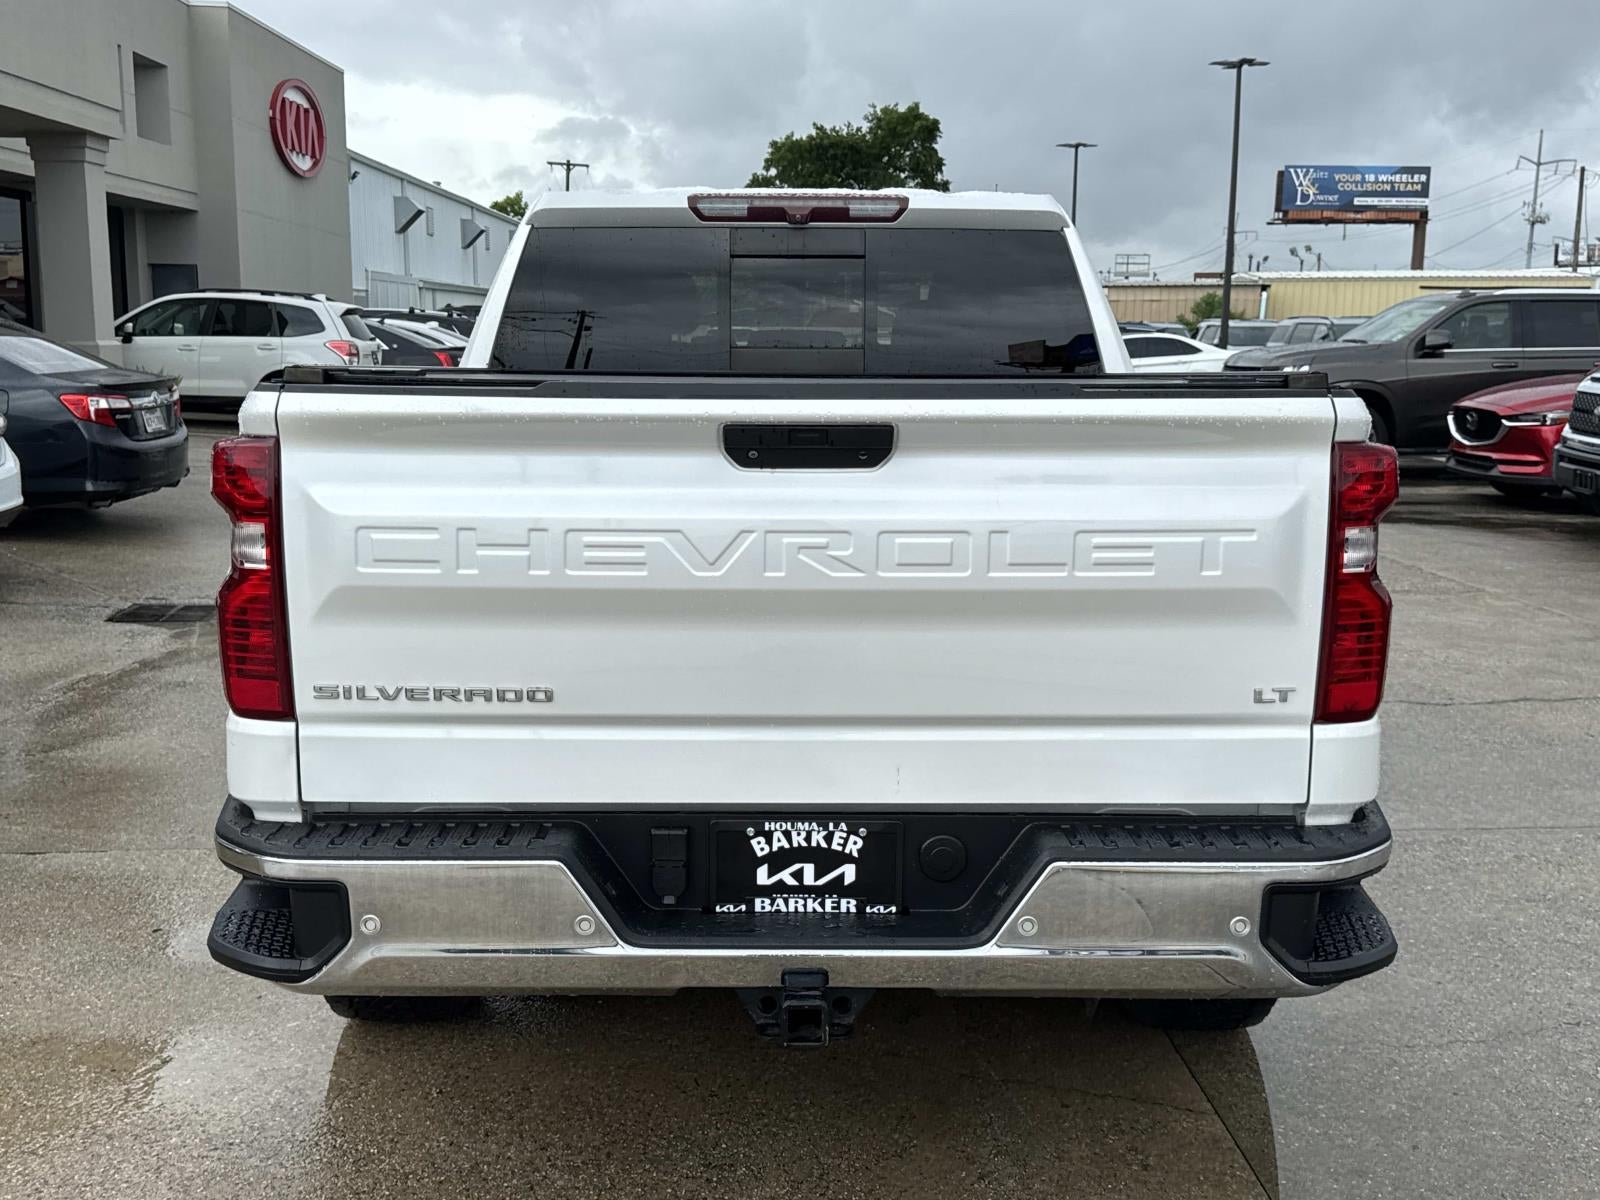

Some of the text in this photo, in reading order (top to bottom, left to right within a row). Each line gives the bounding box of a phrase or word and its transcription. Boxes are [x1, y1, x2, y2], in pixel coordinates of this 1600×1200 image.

[281, 96, 321, 161] KIA
[1334, 173, 1427, 184] YOUR 18 WHEELER
[1337, 182, 1422, 193] COLLISION TEAM
[355, 526, 1258, 578] CHEVROLET
[312, 684, 554, 703] SILVERADO
[1253, 686, 1297, 704] LT
[764, 821, 848, 832] HOUMA, LA
[750, 830, 864, 858] BARKER
[756, 863, 856, 886] KIA
[715, 898, 897, 914] KIA BARKER KIA
